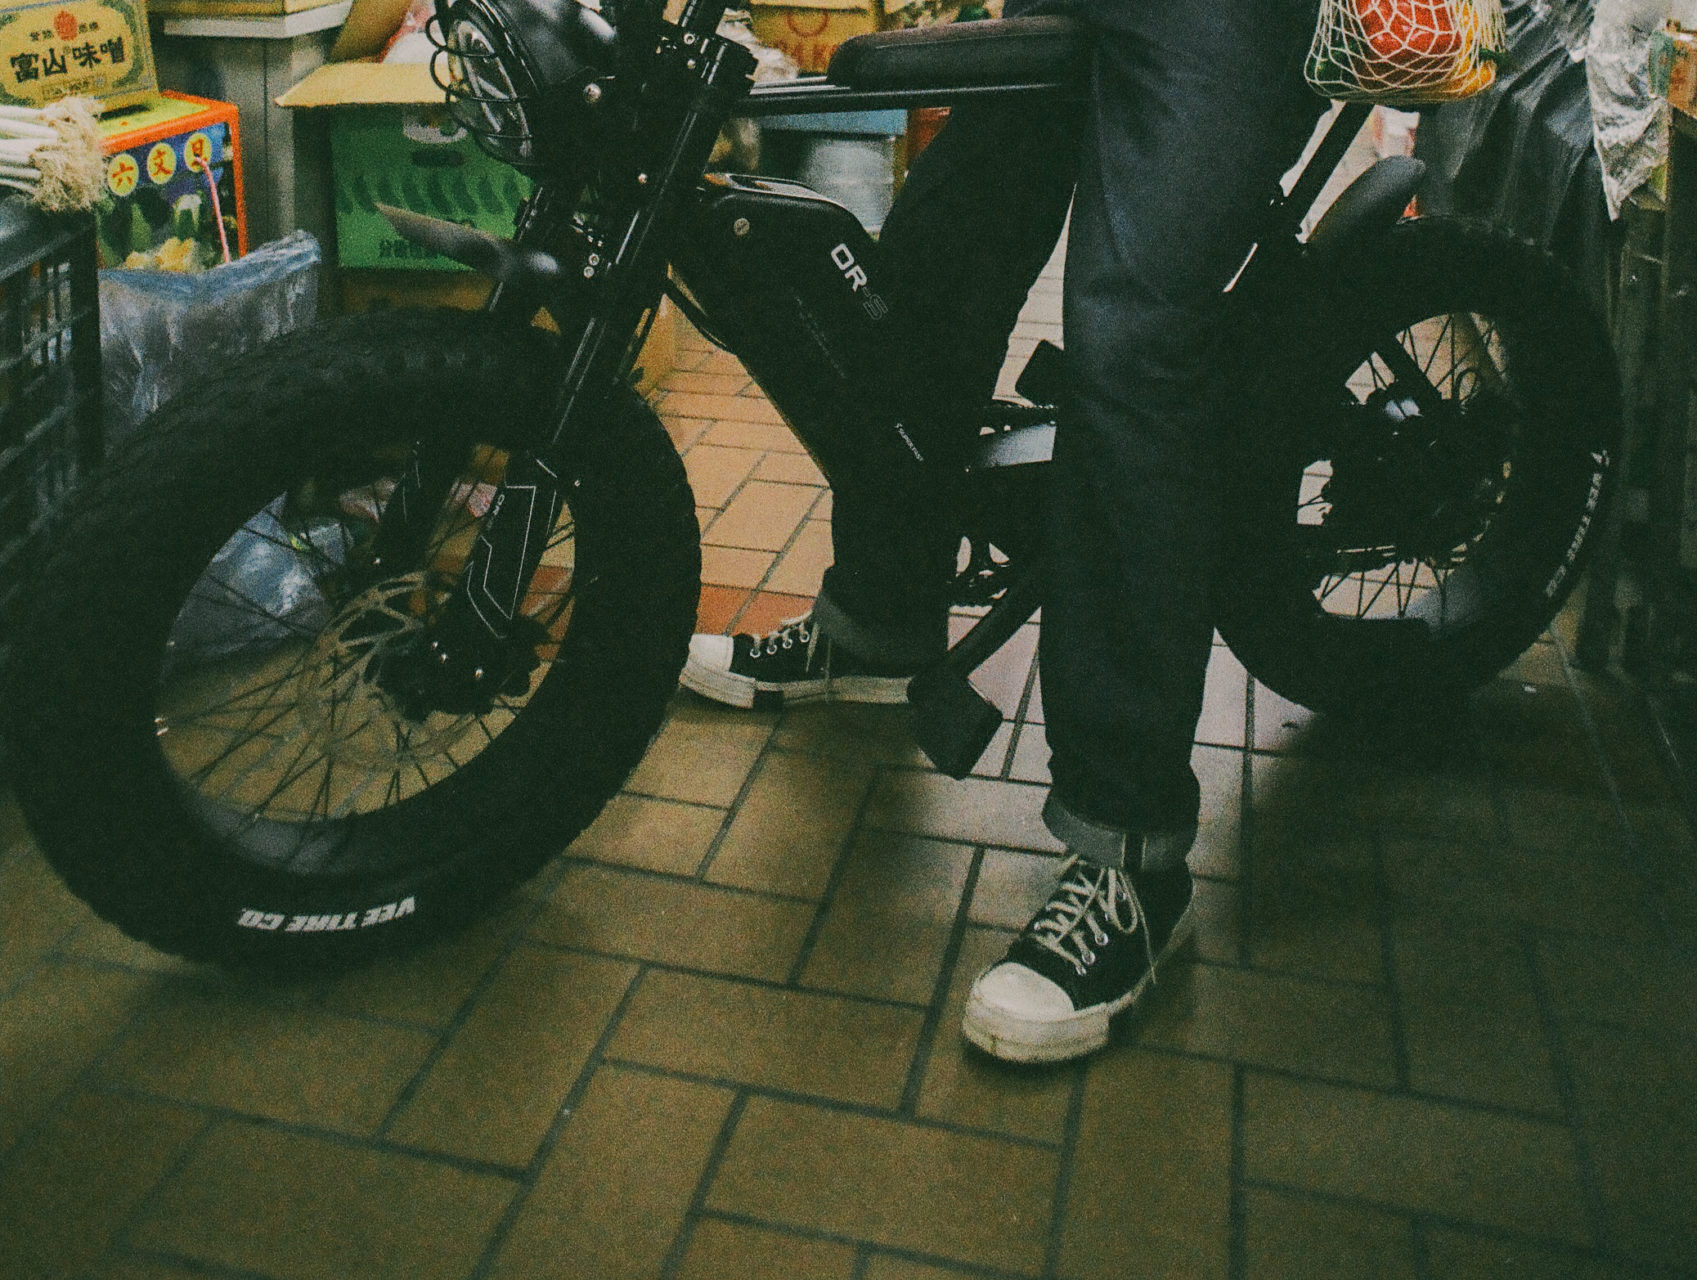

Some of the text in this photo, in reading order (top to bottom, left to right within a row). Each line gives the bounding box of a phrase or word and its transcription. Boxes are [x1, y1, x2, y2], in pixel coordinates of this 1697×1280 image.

[10, 35, 126, 83] 富山味噌
[285, 911, 358, 932] TIRE
[361, 895, 415, 927] VEE
